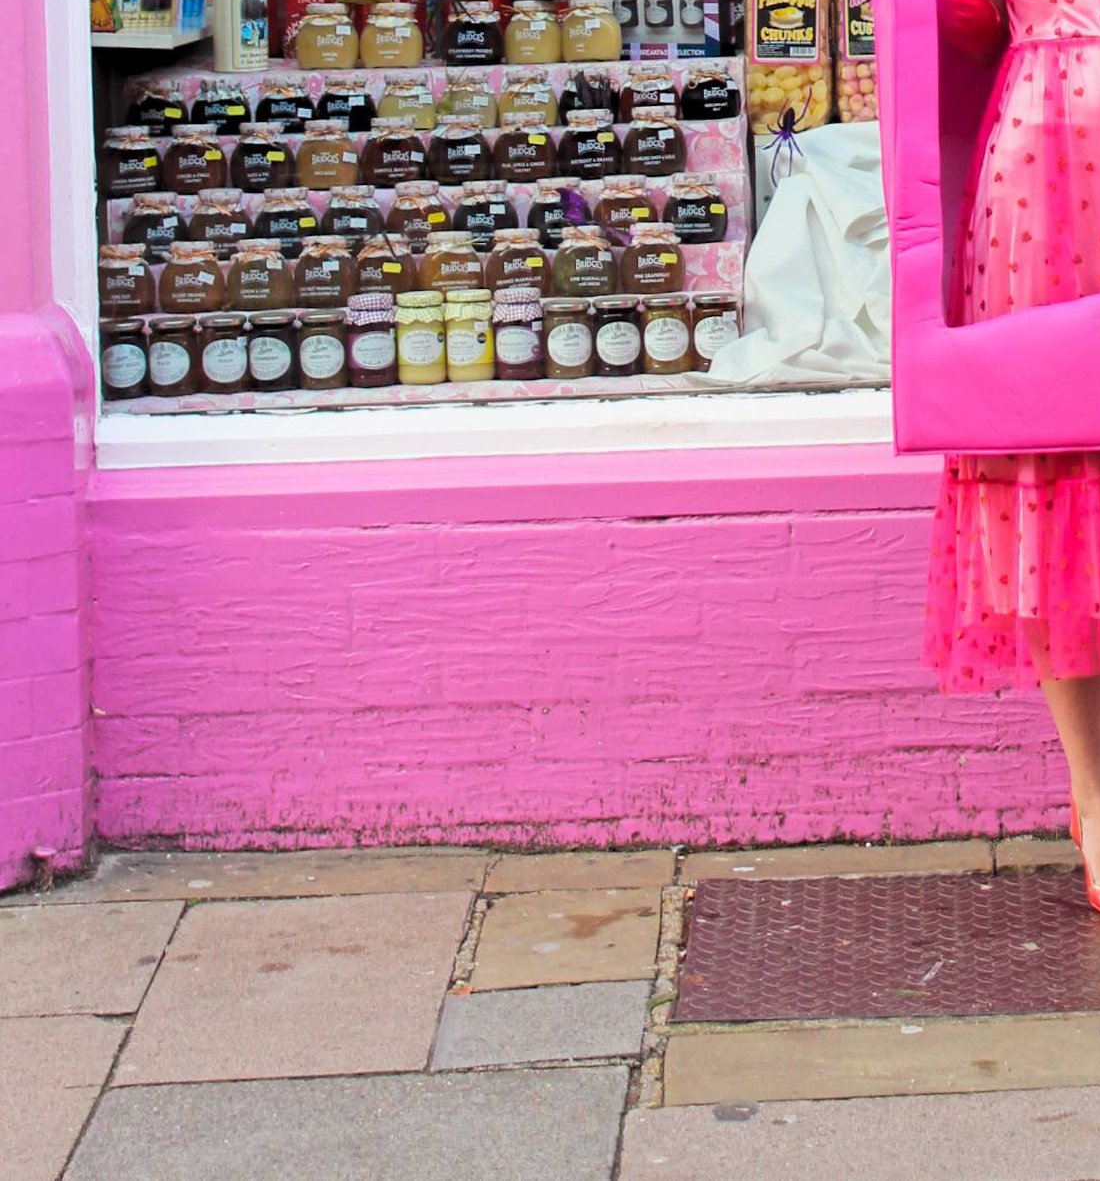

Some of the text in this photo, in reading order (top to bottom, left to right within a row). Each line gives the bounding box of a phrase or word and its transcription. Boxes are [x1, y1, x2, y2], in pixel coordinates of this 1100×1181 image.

[761, 27, 814, 41] CHUNKS
[635, 91, 659, 103] BRIDGES
[703, 88, 729, 100] BRIDGES
[508, 146, 537, 159] BRIDGES
[638, 140, 666, 153] BRIDGES
[312, 154, 340, 166] BRIDGES
[383, 152, 411, 164] BRIDGES
[678, 205, 707, 218] BRIDGES
[270, 220, 298, 233] BRIDGES
[467, 215, 496, 228] BRIDGES
[147, 227, 175, 240] BRIDGES
[576, 258, 604, 271] BRIDGES
[241, 272, 269, 284] BRIDGES
[305, 269, 333, 281] BRIDGES
[107, 277, 136, 290] BRIDGES
